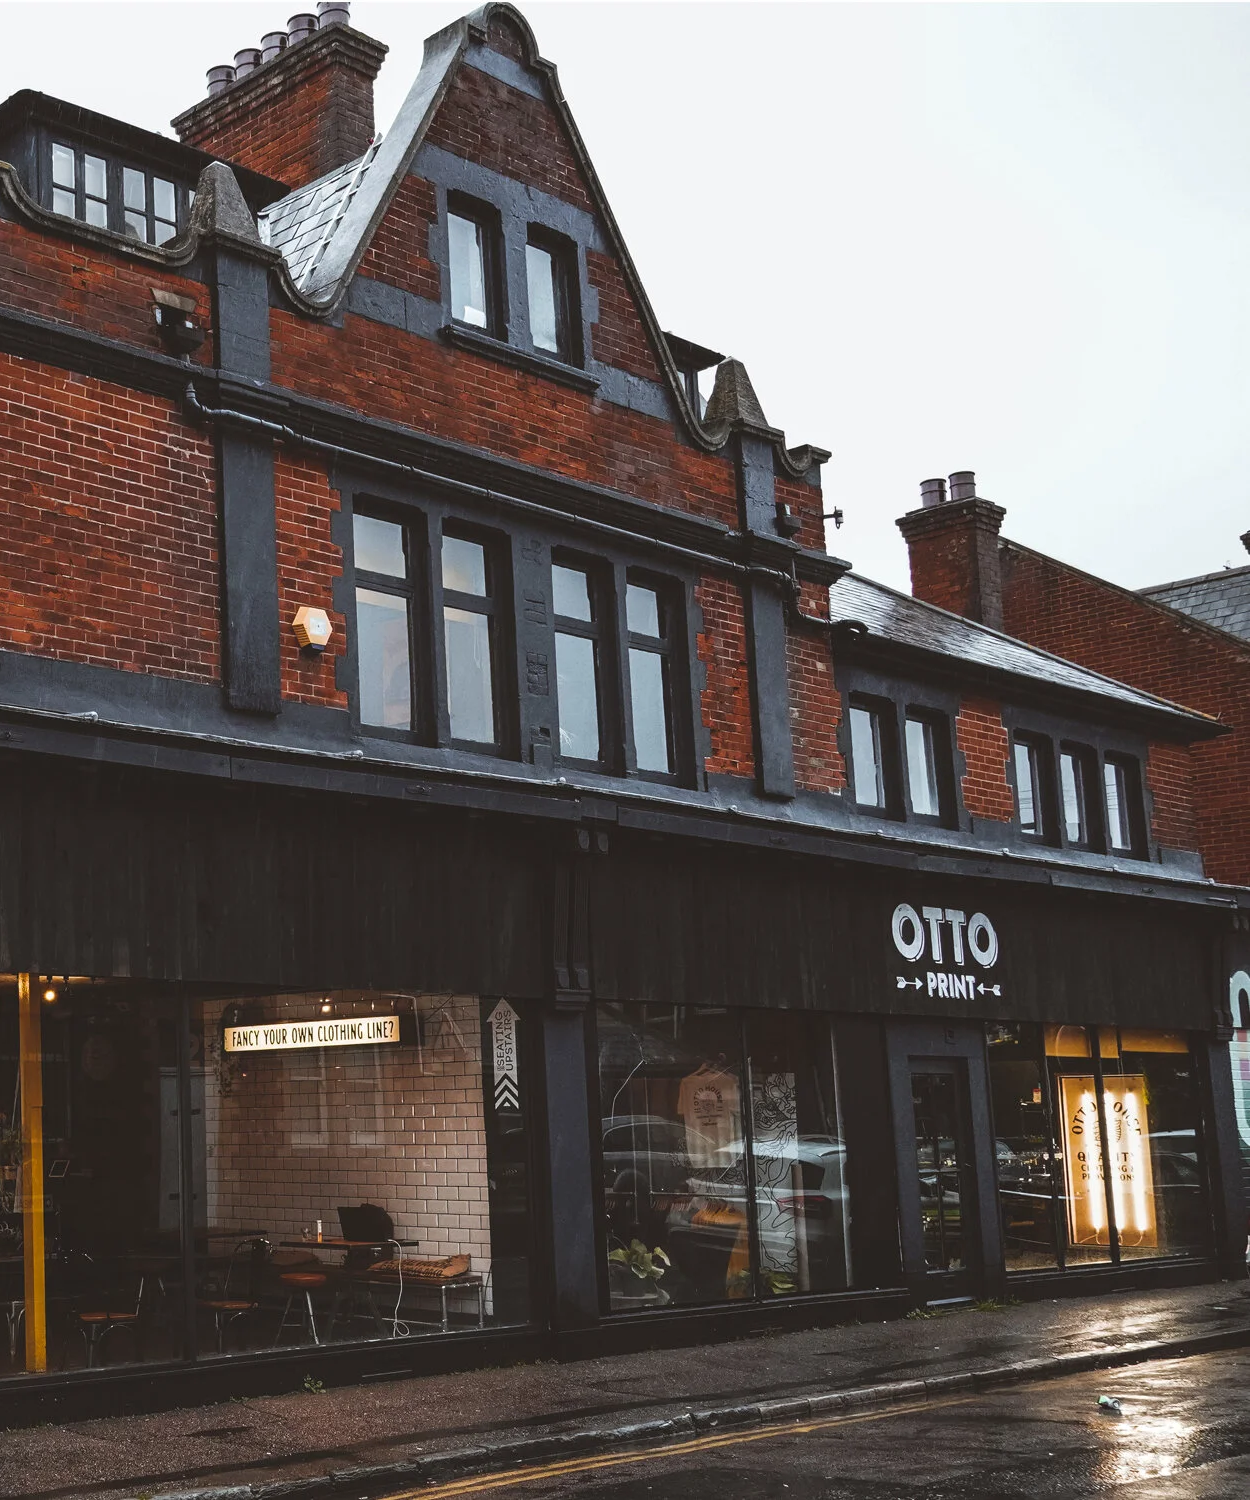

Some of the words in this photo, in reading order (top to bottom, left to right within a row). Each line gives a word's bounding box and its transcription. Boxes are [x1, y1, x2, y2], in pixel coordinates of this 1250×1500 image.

[891, 902, 999, 969] OTTO
[927, 971, 976, 1000] PRINT
[232, 1030, 260, 1047] FANCY
[263, 1028, 288, 1045] YOUR
[291, 1027, 314, 1044] OWN
[317, 1022, 363, 1042] CLOTHING
[366, 1020, 394, 1039] LINE?
[494, 1011, 505, 1066] SEATING
[503, 1010, 514, 1071] UPSTAIRS
